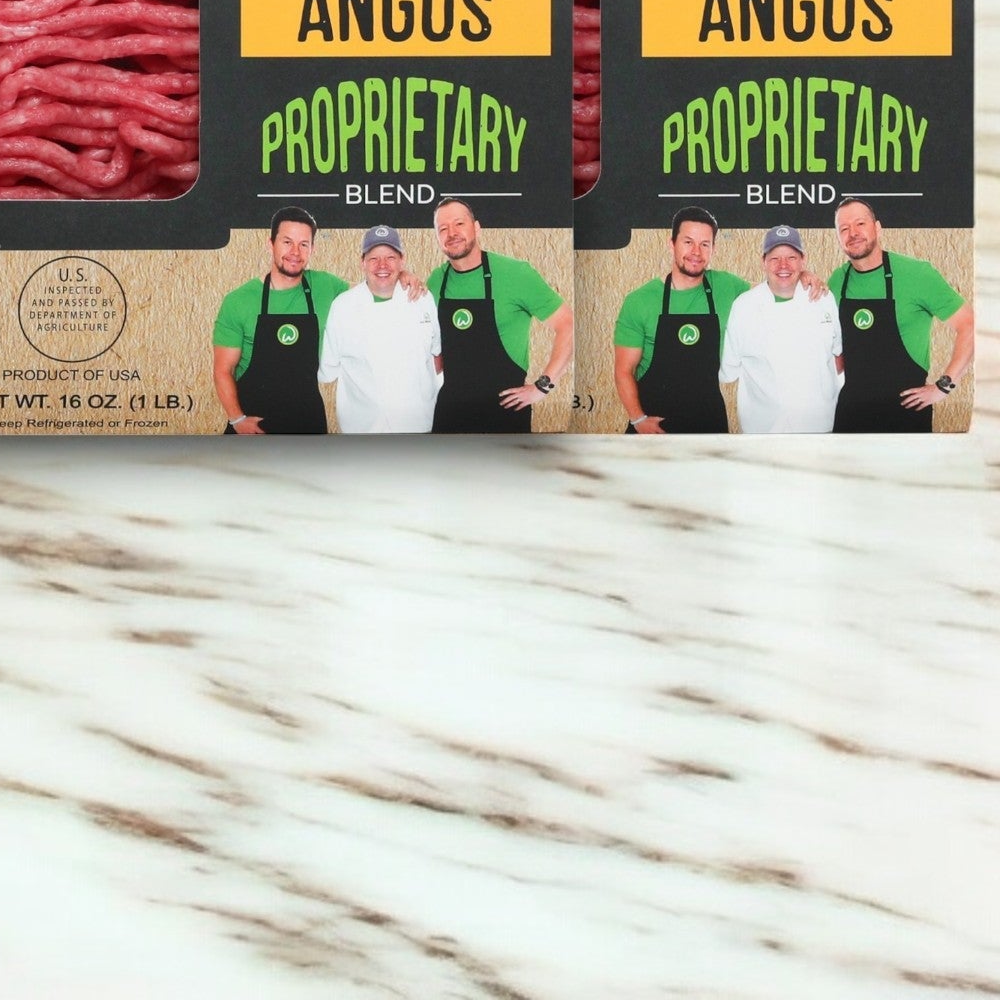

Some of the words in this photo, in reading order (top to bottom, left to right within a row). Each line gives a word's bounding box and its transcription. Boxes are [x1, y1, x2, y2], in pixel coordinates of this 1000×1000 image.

[263, 78, 526, 173] PROPRIETARY
[664, 78, 927, 173] PROPRIETARY
[346, 184, 434, 204] BLEND
[747, 184, 835, 204] BLEND
[43, 286, 103, 295] INSPECTED
[31, 298, 54, 307] AND
[58, 298, 97, 307] PASSED
[102, 298, 115, 307] BY
[29, 310, 99, 319] DEPARTMENT
[103, 310, 117, 319] OF
[36, 323, 109, 332] AGRICULTURE
[3, 370, 78, 380] PRODUCT
[84, 370, 103, 380] OF
[110, 370, 140, 380] USA
[15, 395, 50, 408] WT.
[60, 395, 80, 408] 16
[88, 395, 121, 408] OZ.
[130, 395, 145, 412] (1
[155, 395, 193, 411] LB.)
[28, 420, 103, 429] Refrigerated
